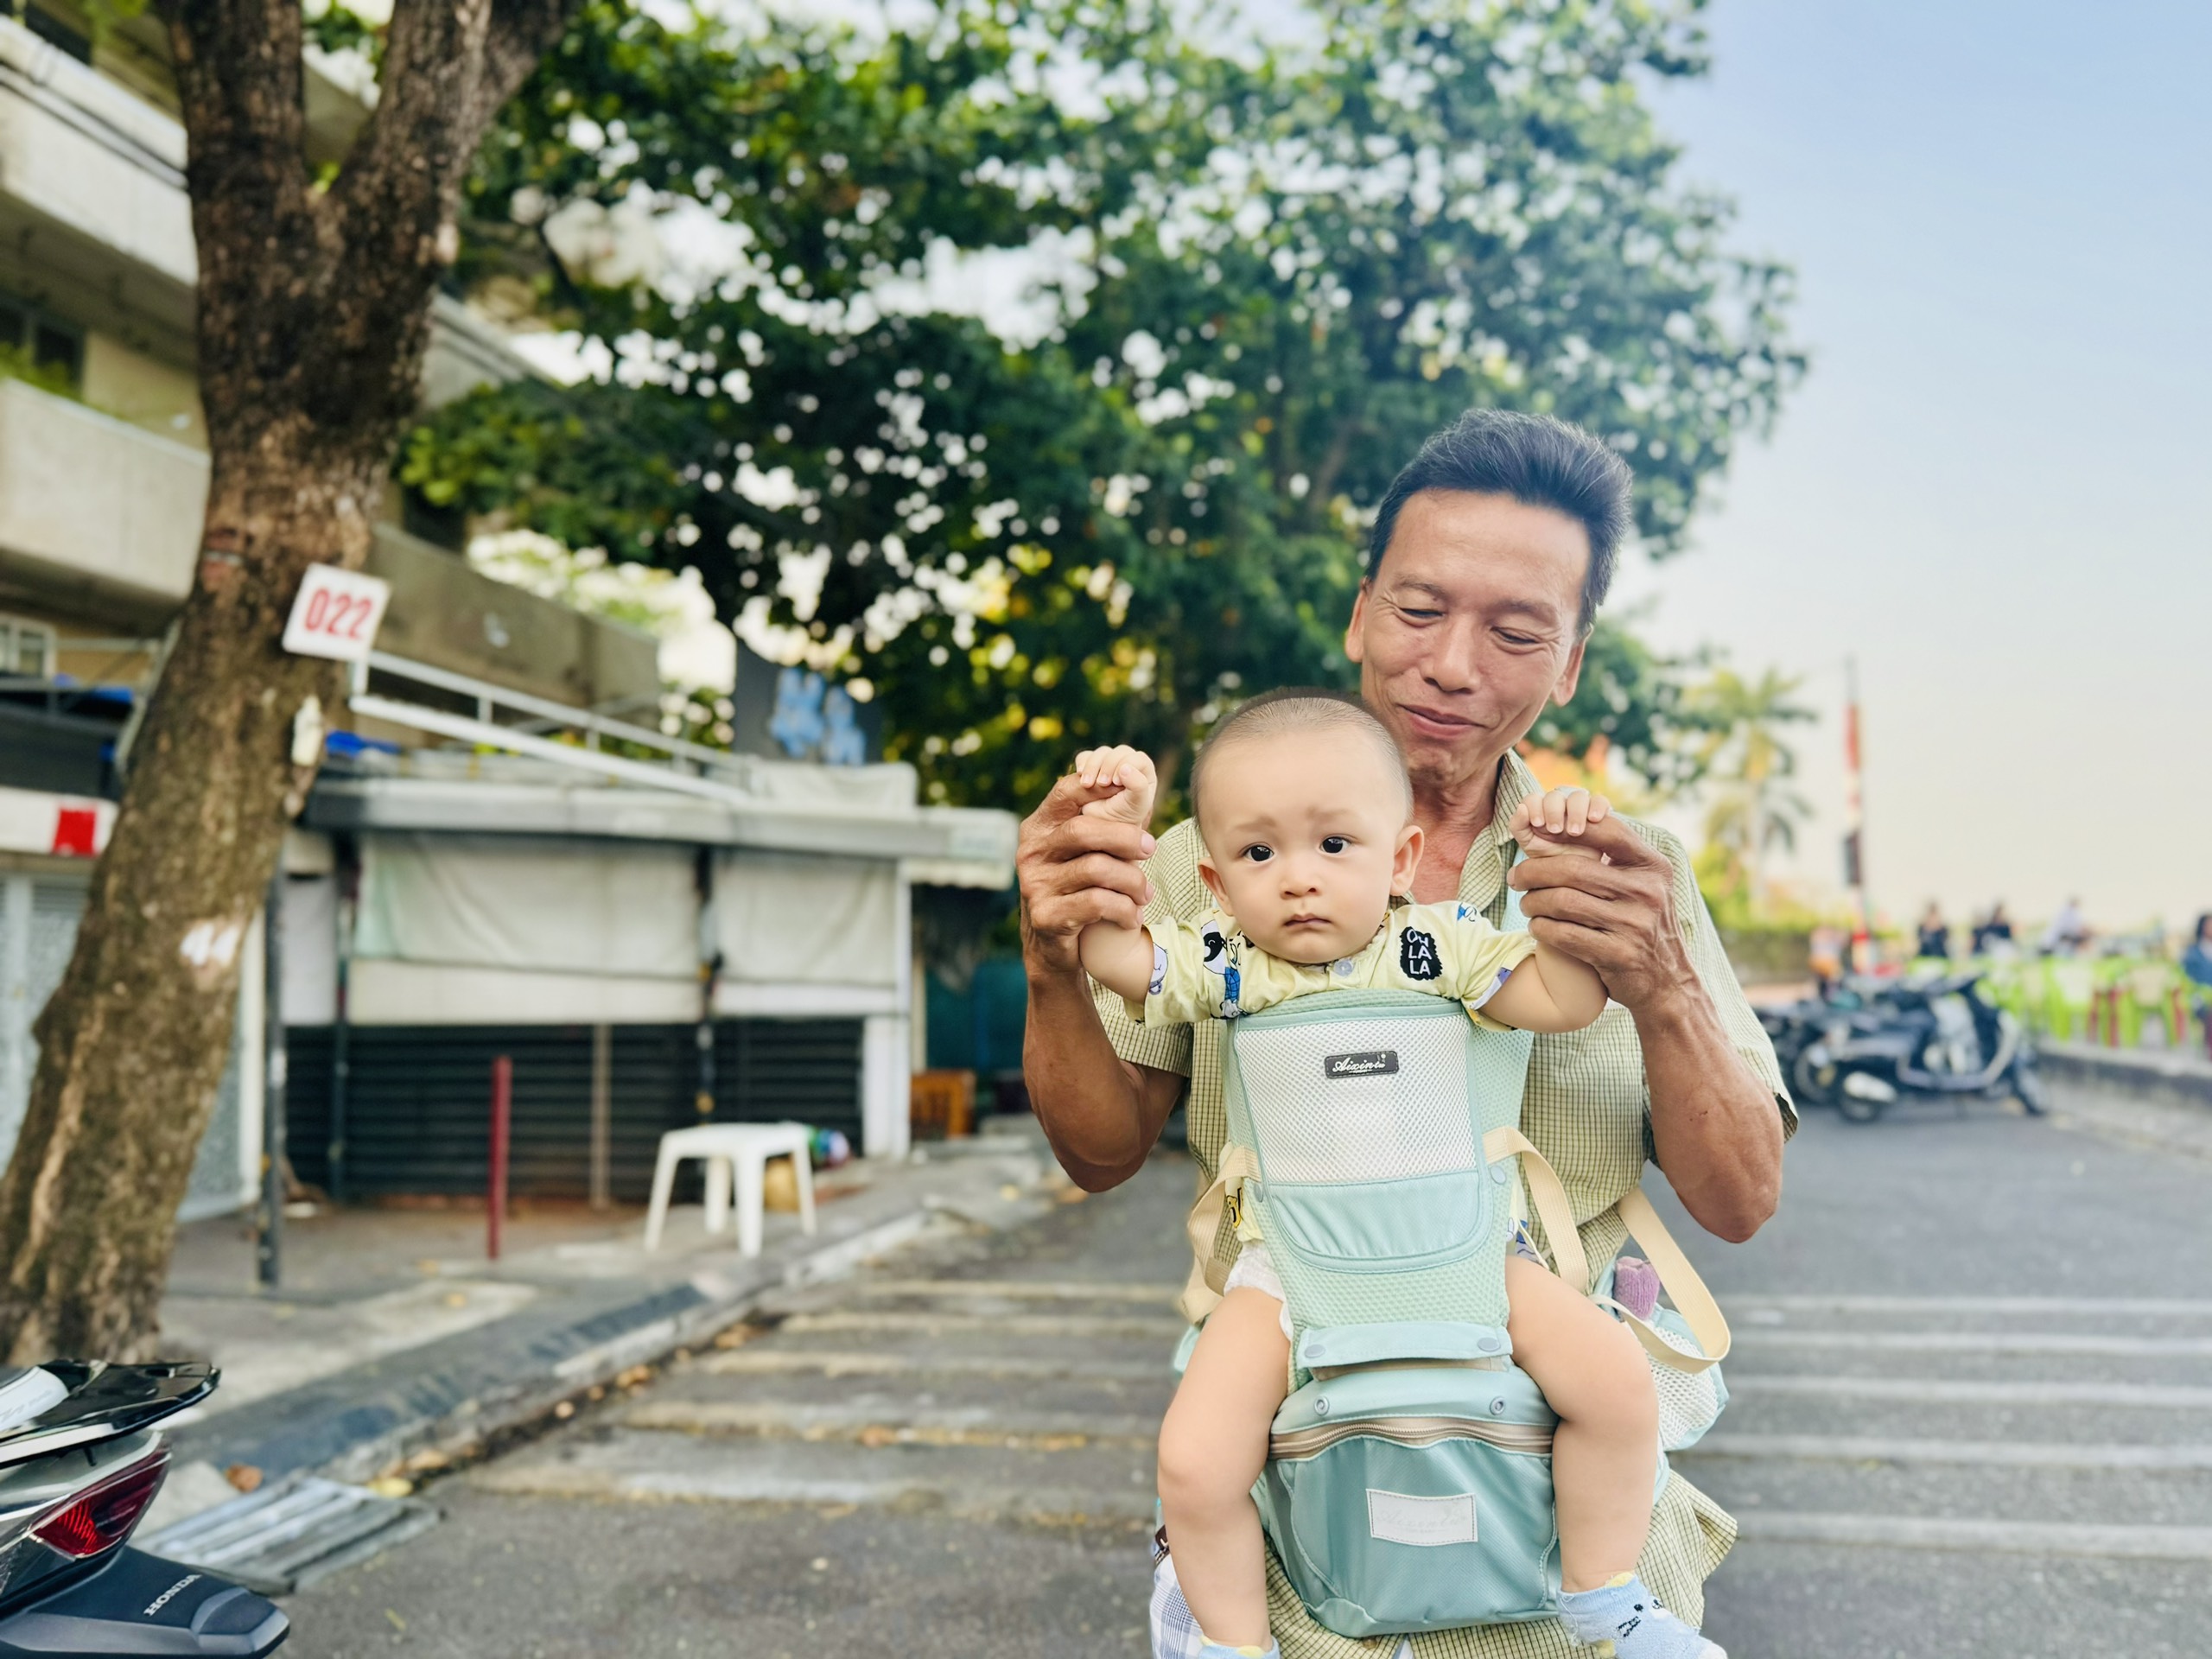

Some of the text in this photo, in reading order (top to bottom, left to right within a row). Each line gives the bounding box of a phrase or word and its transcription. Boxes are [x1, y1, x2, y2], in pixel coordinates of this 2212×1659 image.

[304, 587, 372, 639] 022
[1406, 929, 1429, 948] OH
[1408, 944, 1433, 960] LA
[1409, 959, 1431, 976] LA
[143, 1574, 202, 1617] HONDA
